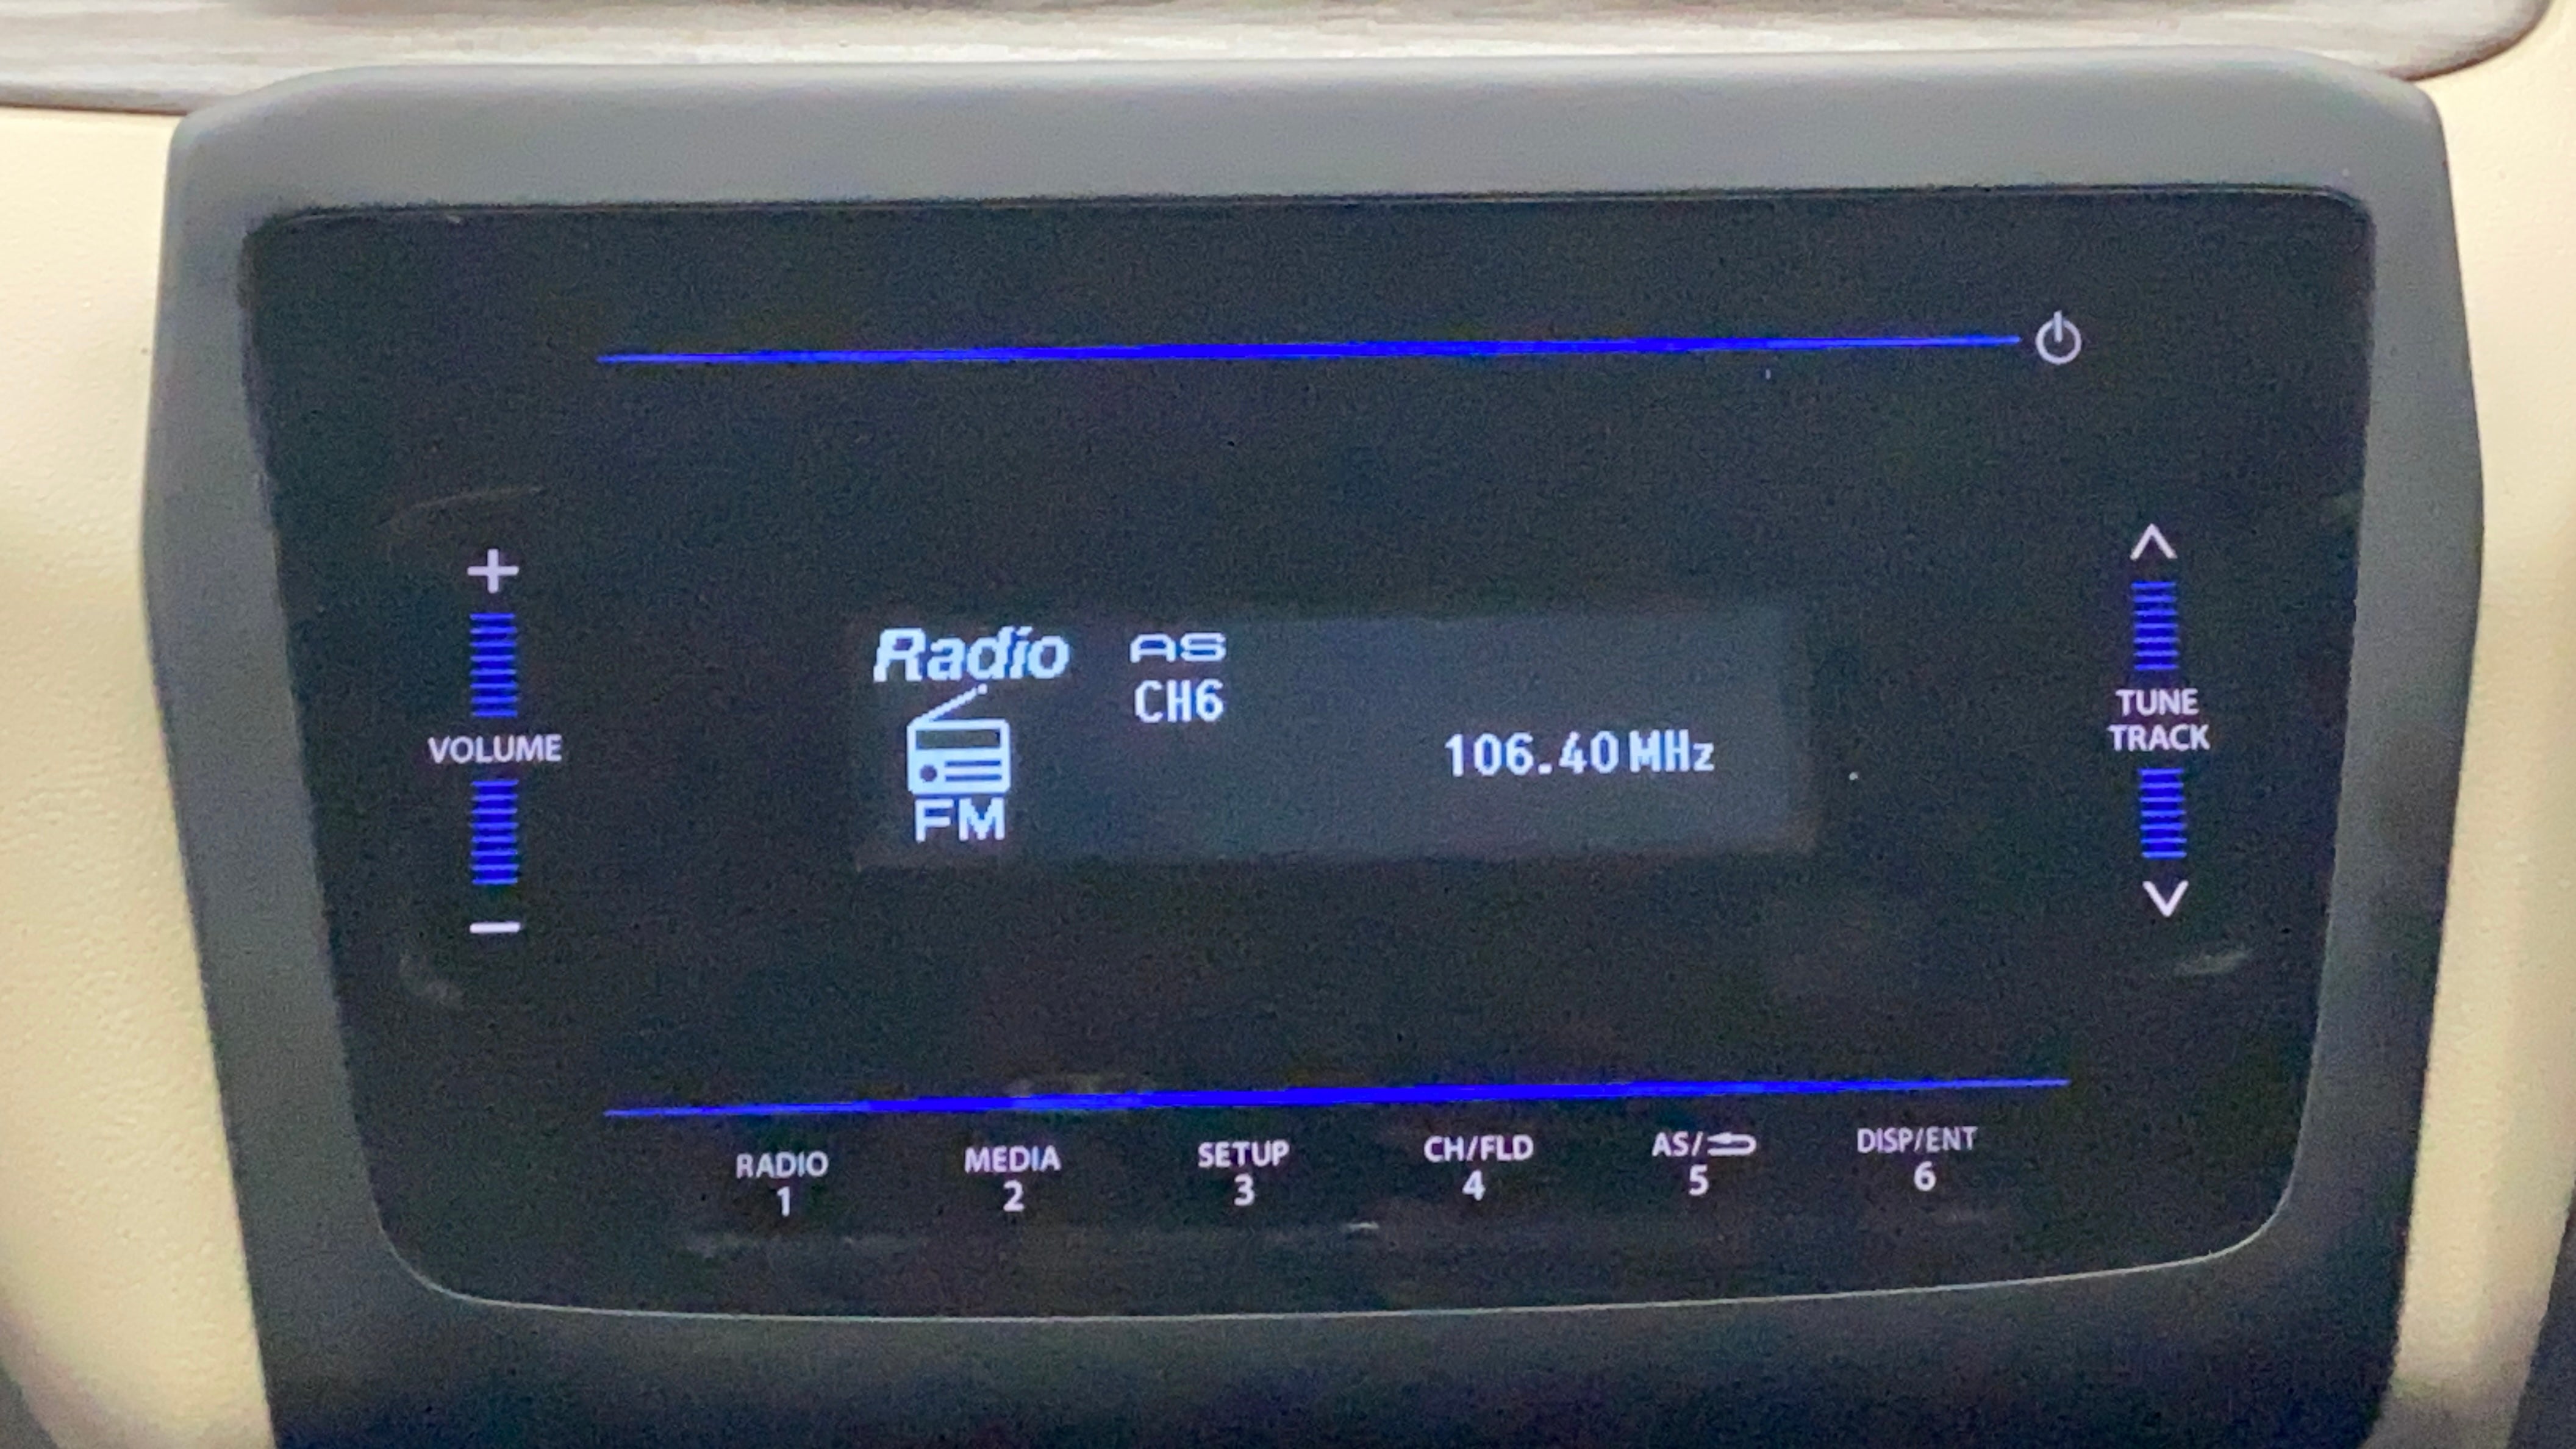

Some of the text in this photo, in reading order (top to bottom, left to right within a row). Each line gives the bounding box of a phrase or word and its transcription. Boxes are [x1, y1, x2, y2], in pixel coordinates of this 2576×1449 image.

[873, 626, 1070, 682] Radio
[1129, 632, 1227, 663] AS
[1134, 679, 1225, 723] CH6
[2115, 688, 2199, 716] TUNE
[428, 734, 563, 764] VOLUME
[2107, 723, 2211, 752] TRACK
[914, 797, 1006, 842] FM
[1198, 1140, 1290, 1168] SETUP
[1424, 1134, 1534, 1162] CH/FLD
[1857, 1126, 1978, 1153] DISP/ENT
[737, 1151, 829, 1178] RADIO
[965, 1145, 1061, 1173] MEDIA
[1234, 1173, 1255, 1206] 3
[1462, 1170, 1486, 1201] 4
[1689, 1164, 1709, 1196] 5
[1914, 1161, 1936, 1192] 6
[777, 1186, 790, 1217] 1
[1003, 1179, 1025, 1212] 2
